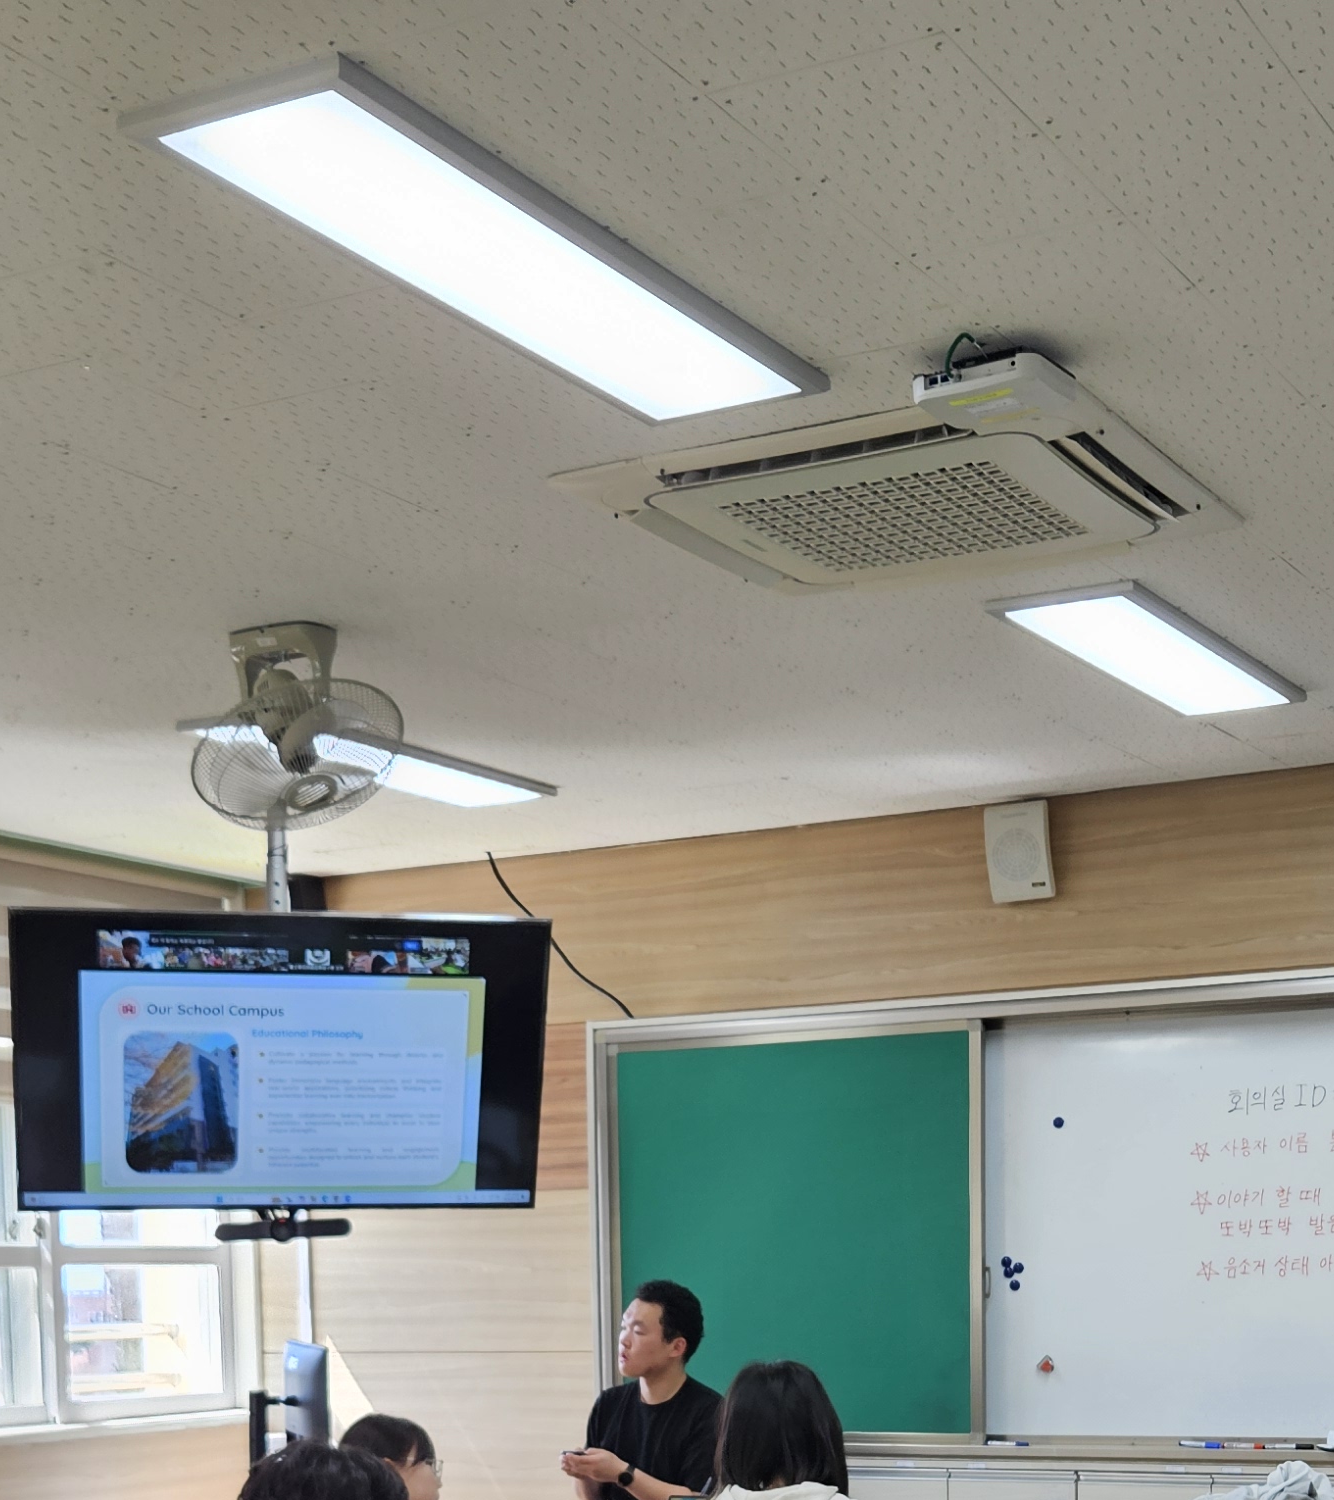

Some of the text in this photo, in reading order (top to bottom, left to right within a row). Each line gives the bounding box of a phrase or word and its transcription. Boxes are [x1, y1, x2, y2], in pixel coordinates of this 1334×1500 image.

[147, 1004, 285, 1020] Our School Campus
[252, 1029, 364, 1041] Educational Philosophy
[1228, 1085, 1285, 1115] 회의실
[1220, 1137, 1267, 1157] 사용자
[1280, 1132, 1308, 1154] 이름
[1217, 1189, 1264, 1208] 이야기
[1276, 1186, 1291, 1208] 할
[1299, 1188, 1321, 1206] 때
[1220, 1217, 1292, 1237] 또박또박
[1224, 1257, 1265, 1279] 음소거
[1274, 1256, 1308, 1278] 상태
